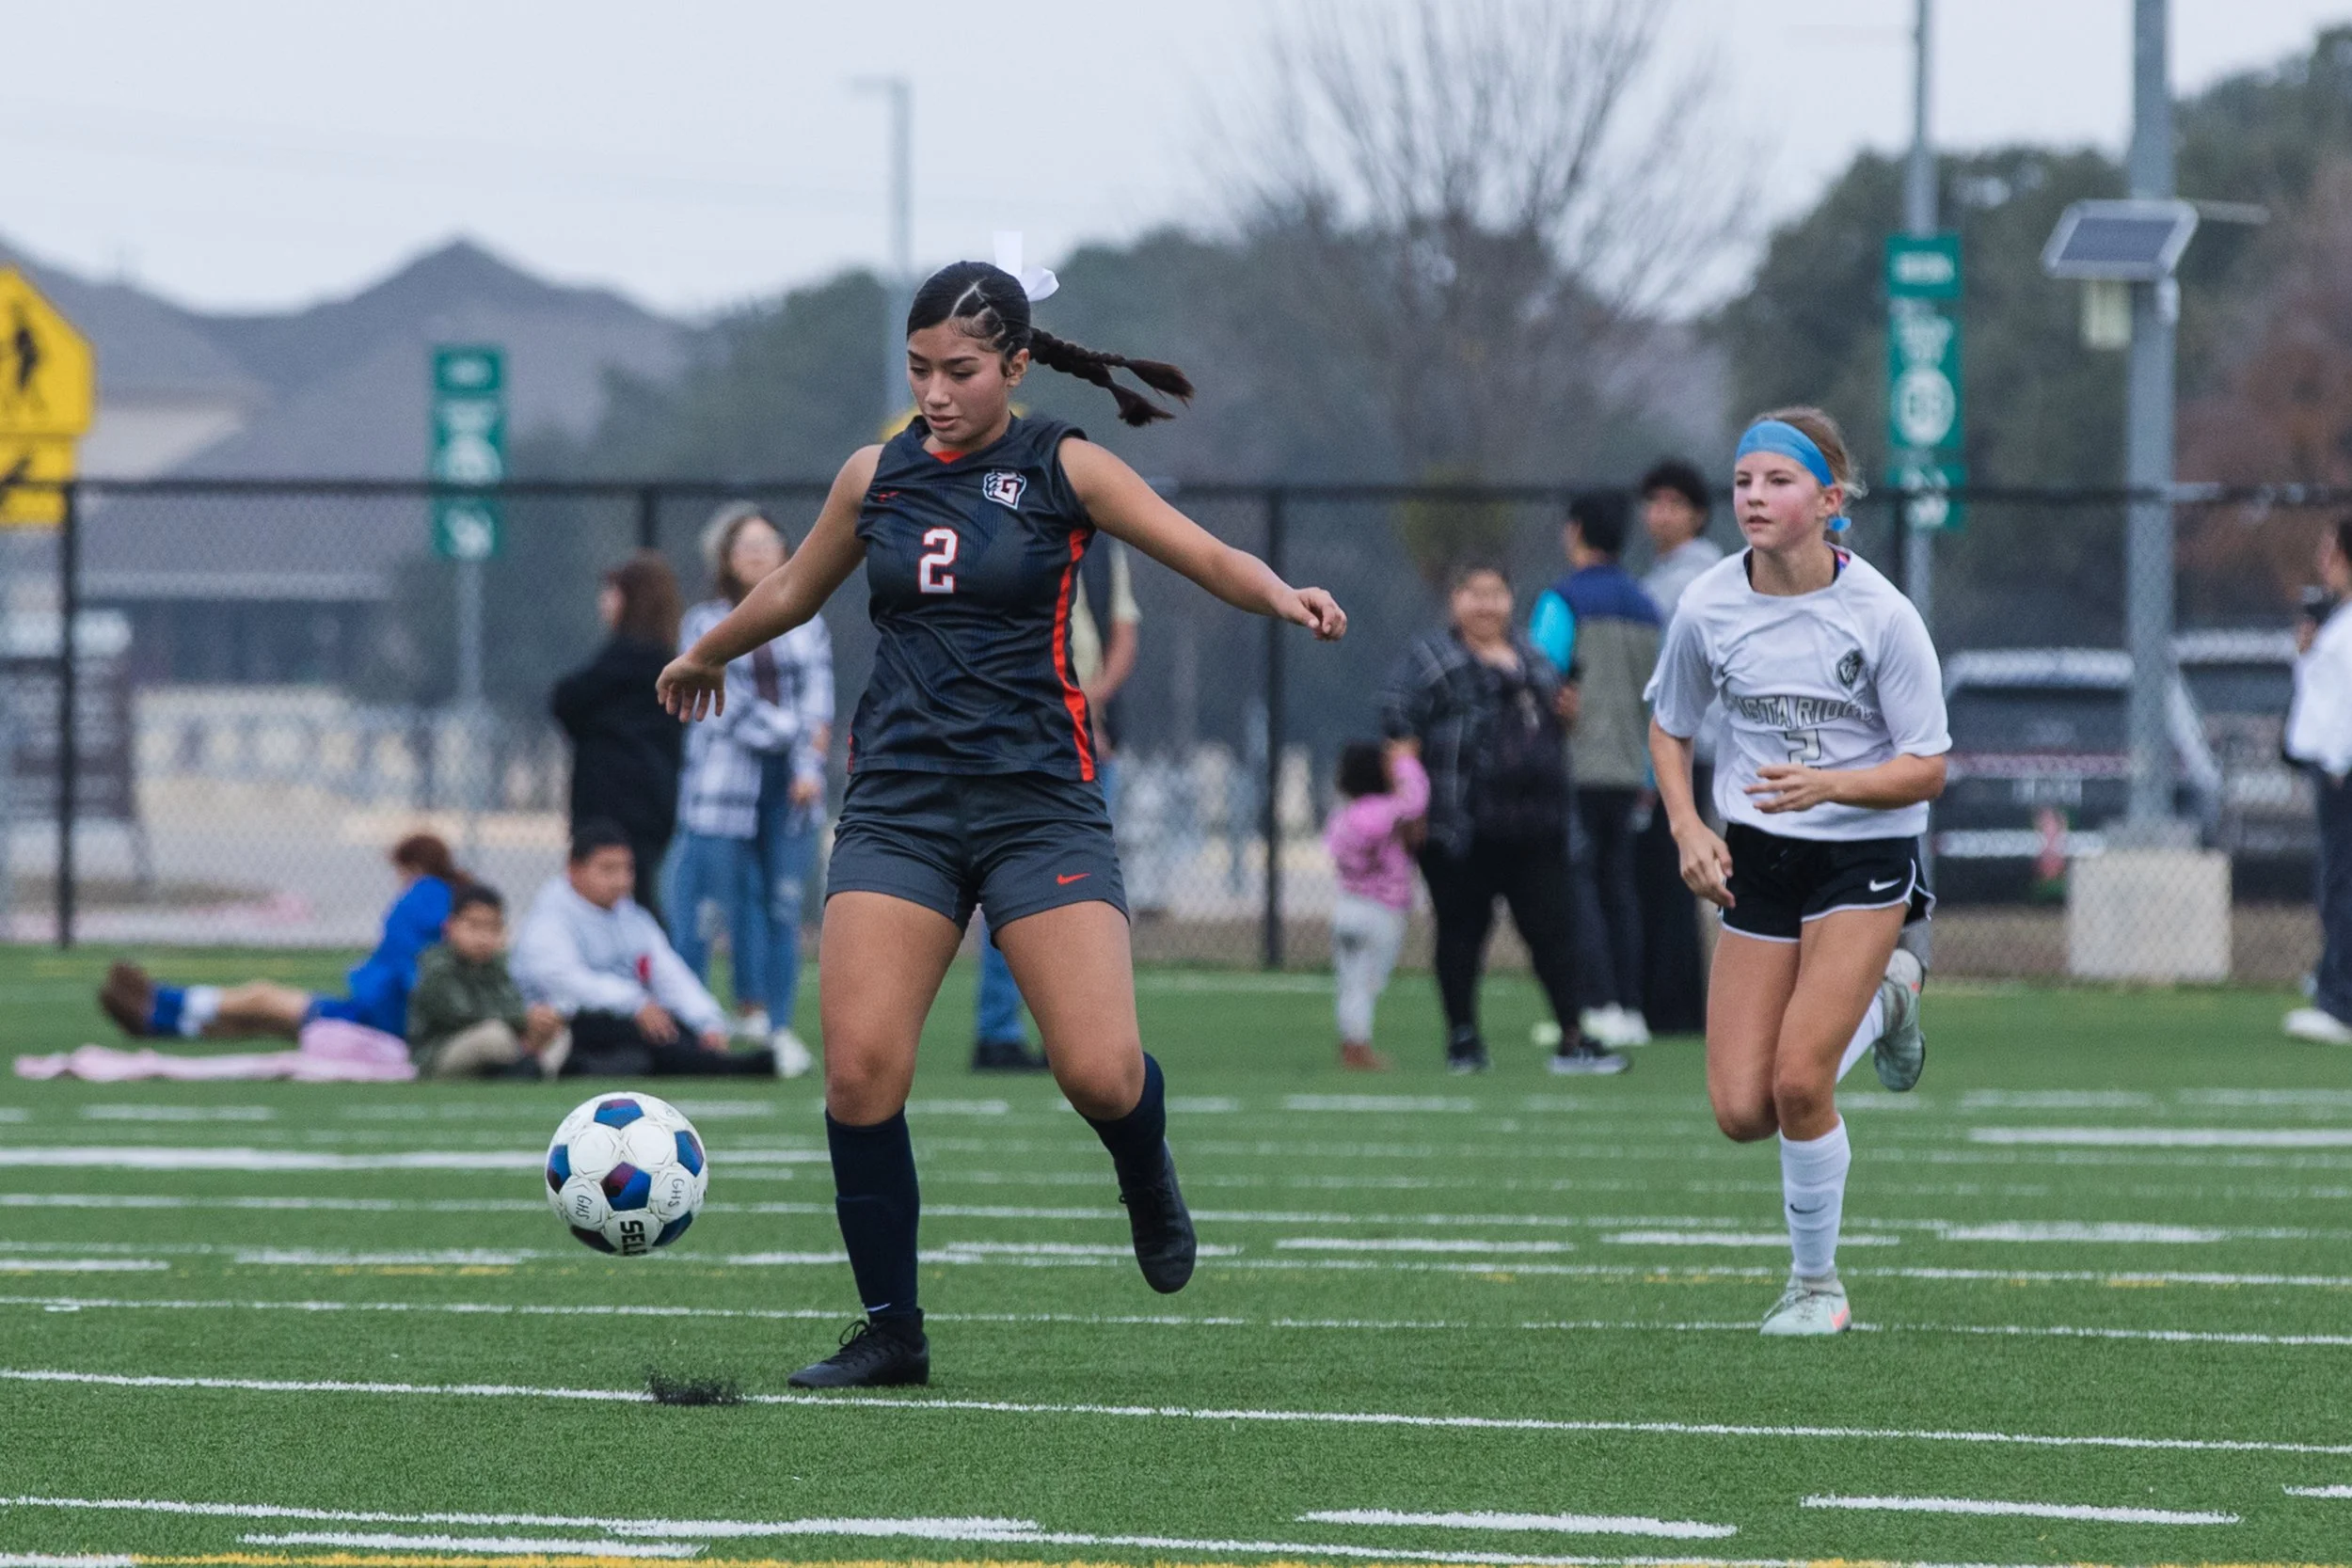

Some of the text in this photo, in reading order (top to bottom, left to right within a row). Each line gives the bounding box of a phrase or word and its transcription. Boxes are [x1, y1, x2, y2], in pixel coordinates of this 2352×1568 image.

[919, 527, 959, 594] 2
[1785, 728, 1821, 769] 2
[576, 1195, 593, 1220] GHS
[668, 1178, 685, 1208] GHS
